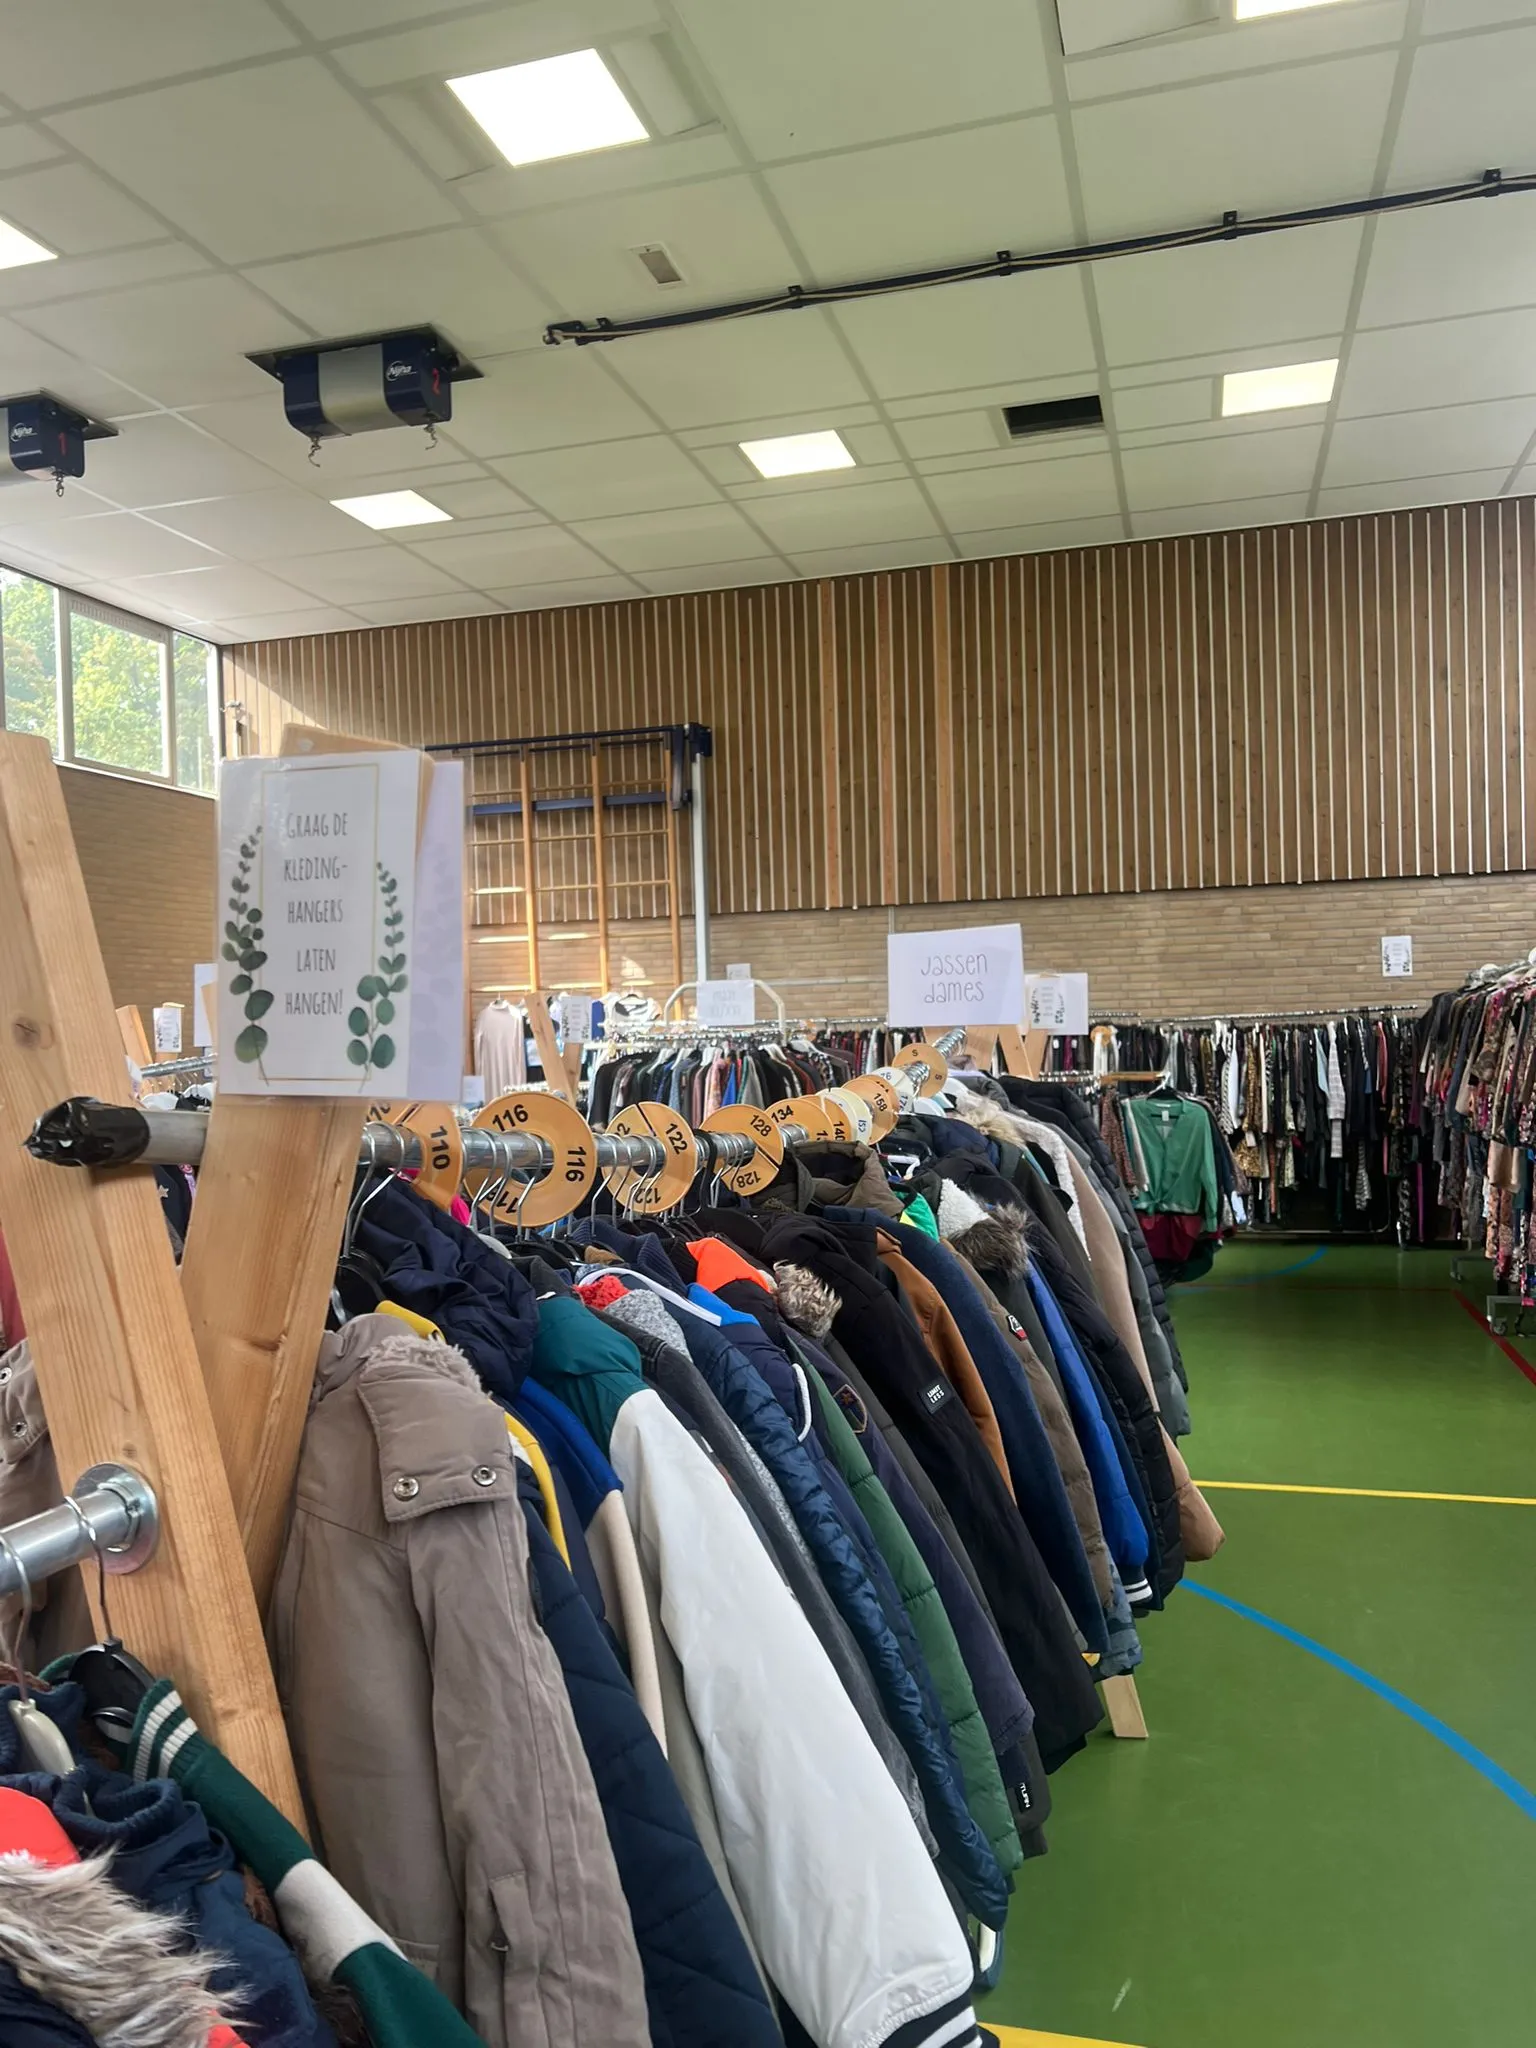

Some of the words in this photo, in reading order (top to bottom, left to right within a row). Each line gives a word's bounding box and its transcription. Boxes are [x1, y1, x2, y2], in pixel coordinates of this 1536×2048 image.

[286, 813, 329, 838] GRAAG
[332, 812, 349, 836] DE
[284, 856, 349, 882] KLEDING-
[287, 899, 343, 924] HANGERS
[296, 949, 336, 972] LATEN
[285, 989, 344, 1016] HANGEN!
[924, 981, 985, 1004] dames
[912, 1049, 918, 1057] S
[492, 1104, 528, 1132] 116
[750, 1114, 772, 1137] 128
[771, 1105, 794, 1123] 134
[665, 1123, 688, 1155] 122
[833, 1120, 846, 1141] 140
[431, 1125, 451, 1170] 110
[565, 1146, 587, 1182] 116
[736, 1170, 762, 1188] 128
[930, 1390, 944, 1404] LESS
